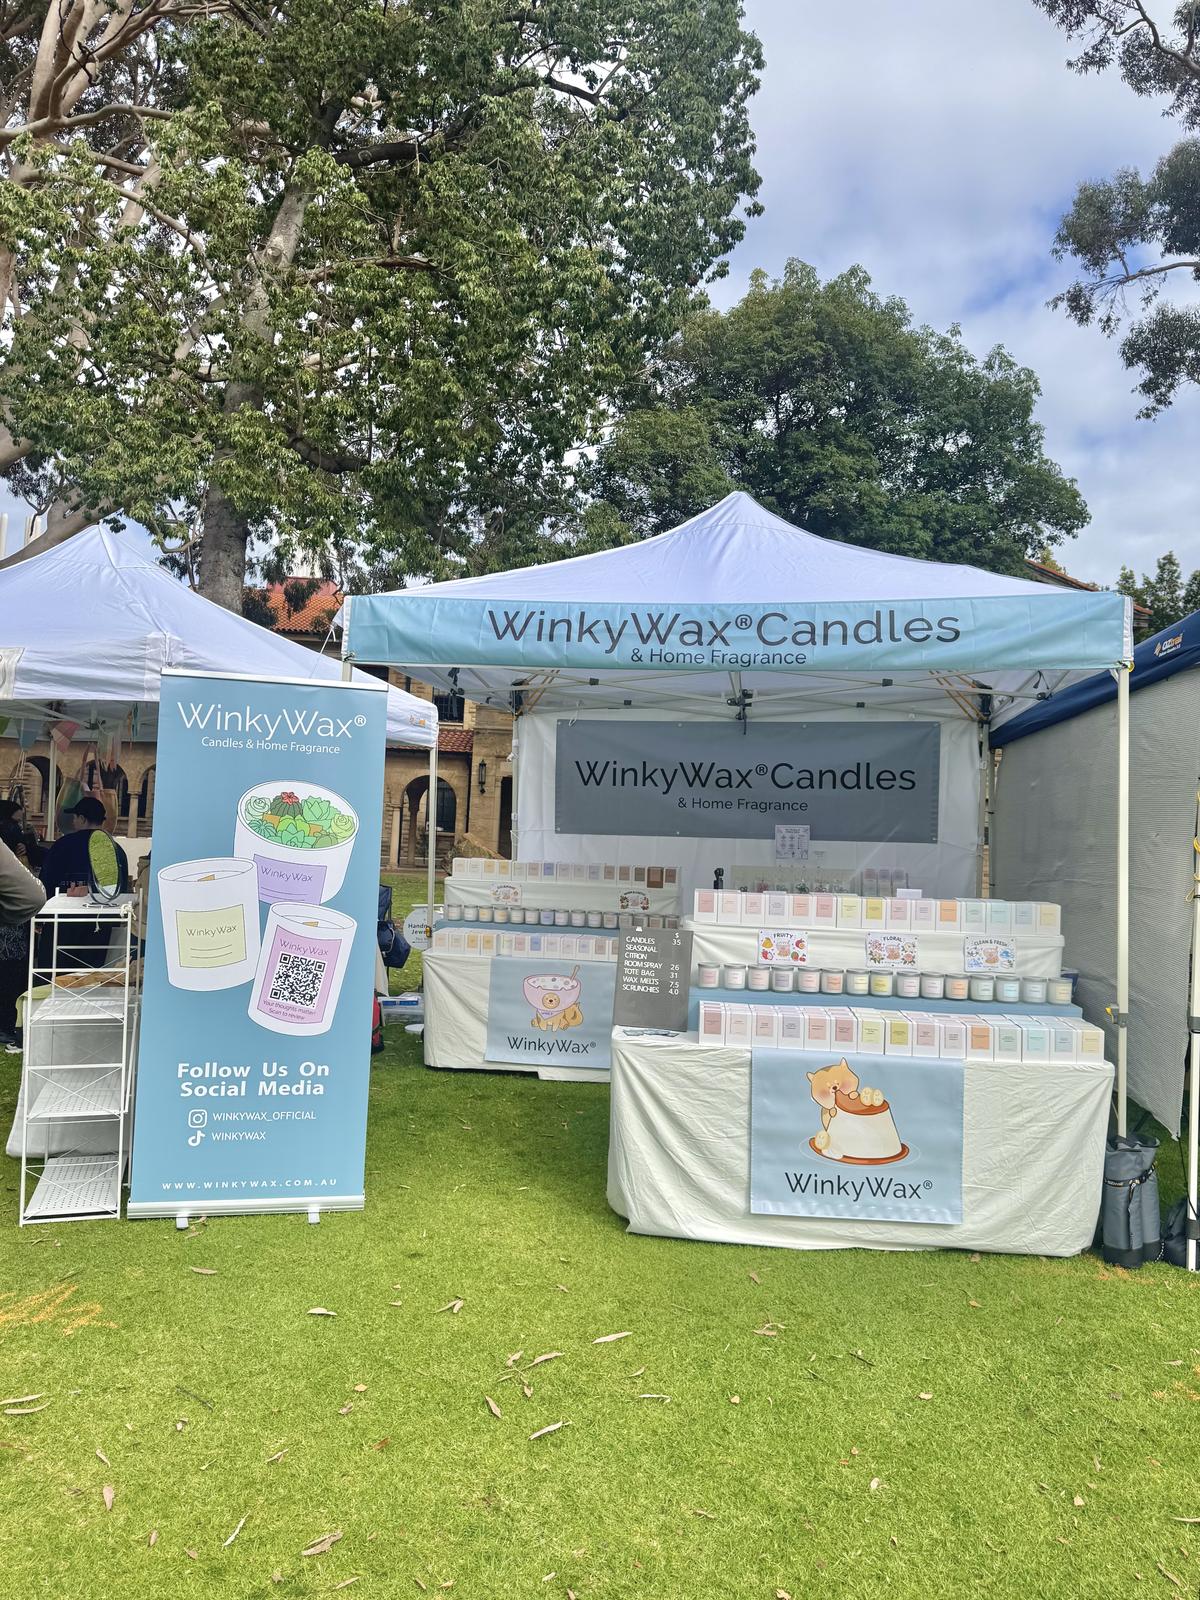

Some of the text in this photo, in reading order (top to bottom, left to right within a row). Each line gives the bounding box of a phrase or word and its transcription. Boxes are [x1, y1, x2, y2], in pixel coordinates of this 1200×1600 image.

[630, 647, 807, 668] & Home Fragrance
[201, 736, 340, 754] Candles & Home Fragrance
[677, 797, 809, 814] & Home Fragrance
[261, 865, 313, 882] WinkyWax
[186, 924, 238, 938] WinkyWax
[626, 936, 656, 944] CANDLES
[882, 935, 903, 943] FLORAL
[280, 938, 329, 957] WinkyWax
[626, 944, 658, 952] SEASONAL
[624, 967, 638, 975] TOTE
[640, 977, 658, 985] MELTS
[275, 1002, 297, 1012] thoughts
[177, 1061, 330, 1079] Follow Us On
[180, 1080, 324, 1097] Social Media
[212, 1111, 316, 1122] WINKYWAX_OFFICIAL
[211, 1131, 266, 1141] WINKYWAX
